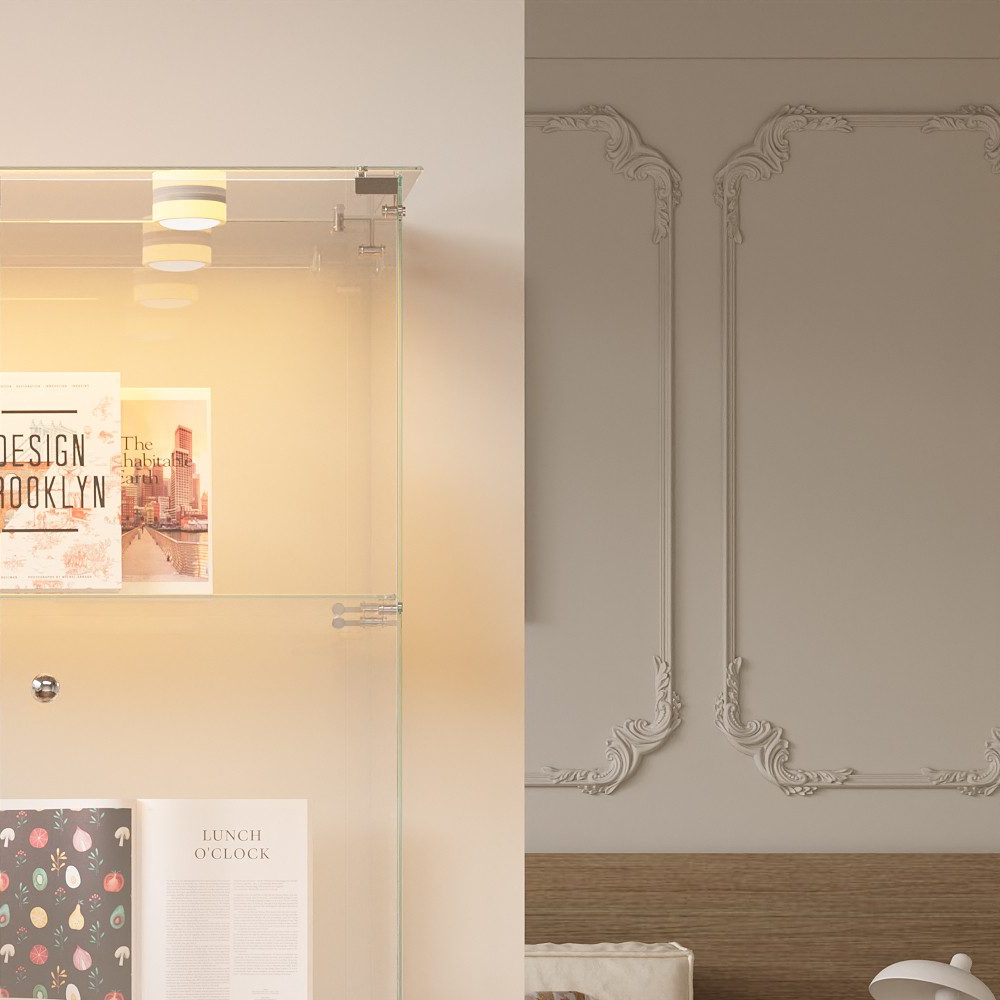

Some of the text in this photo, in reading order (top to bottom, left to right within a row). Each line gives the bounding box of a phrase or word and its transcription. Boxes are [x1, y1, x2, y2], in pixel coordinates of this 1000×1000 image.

[120, 436, 153, 451] The
[120, 452, 193, 468] habitable
[201, 829, 263, 842] LUNCH
[193, 847, 271, 860] O'CLOCK
